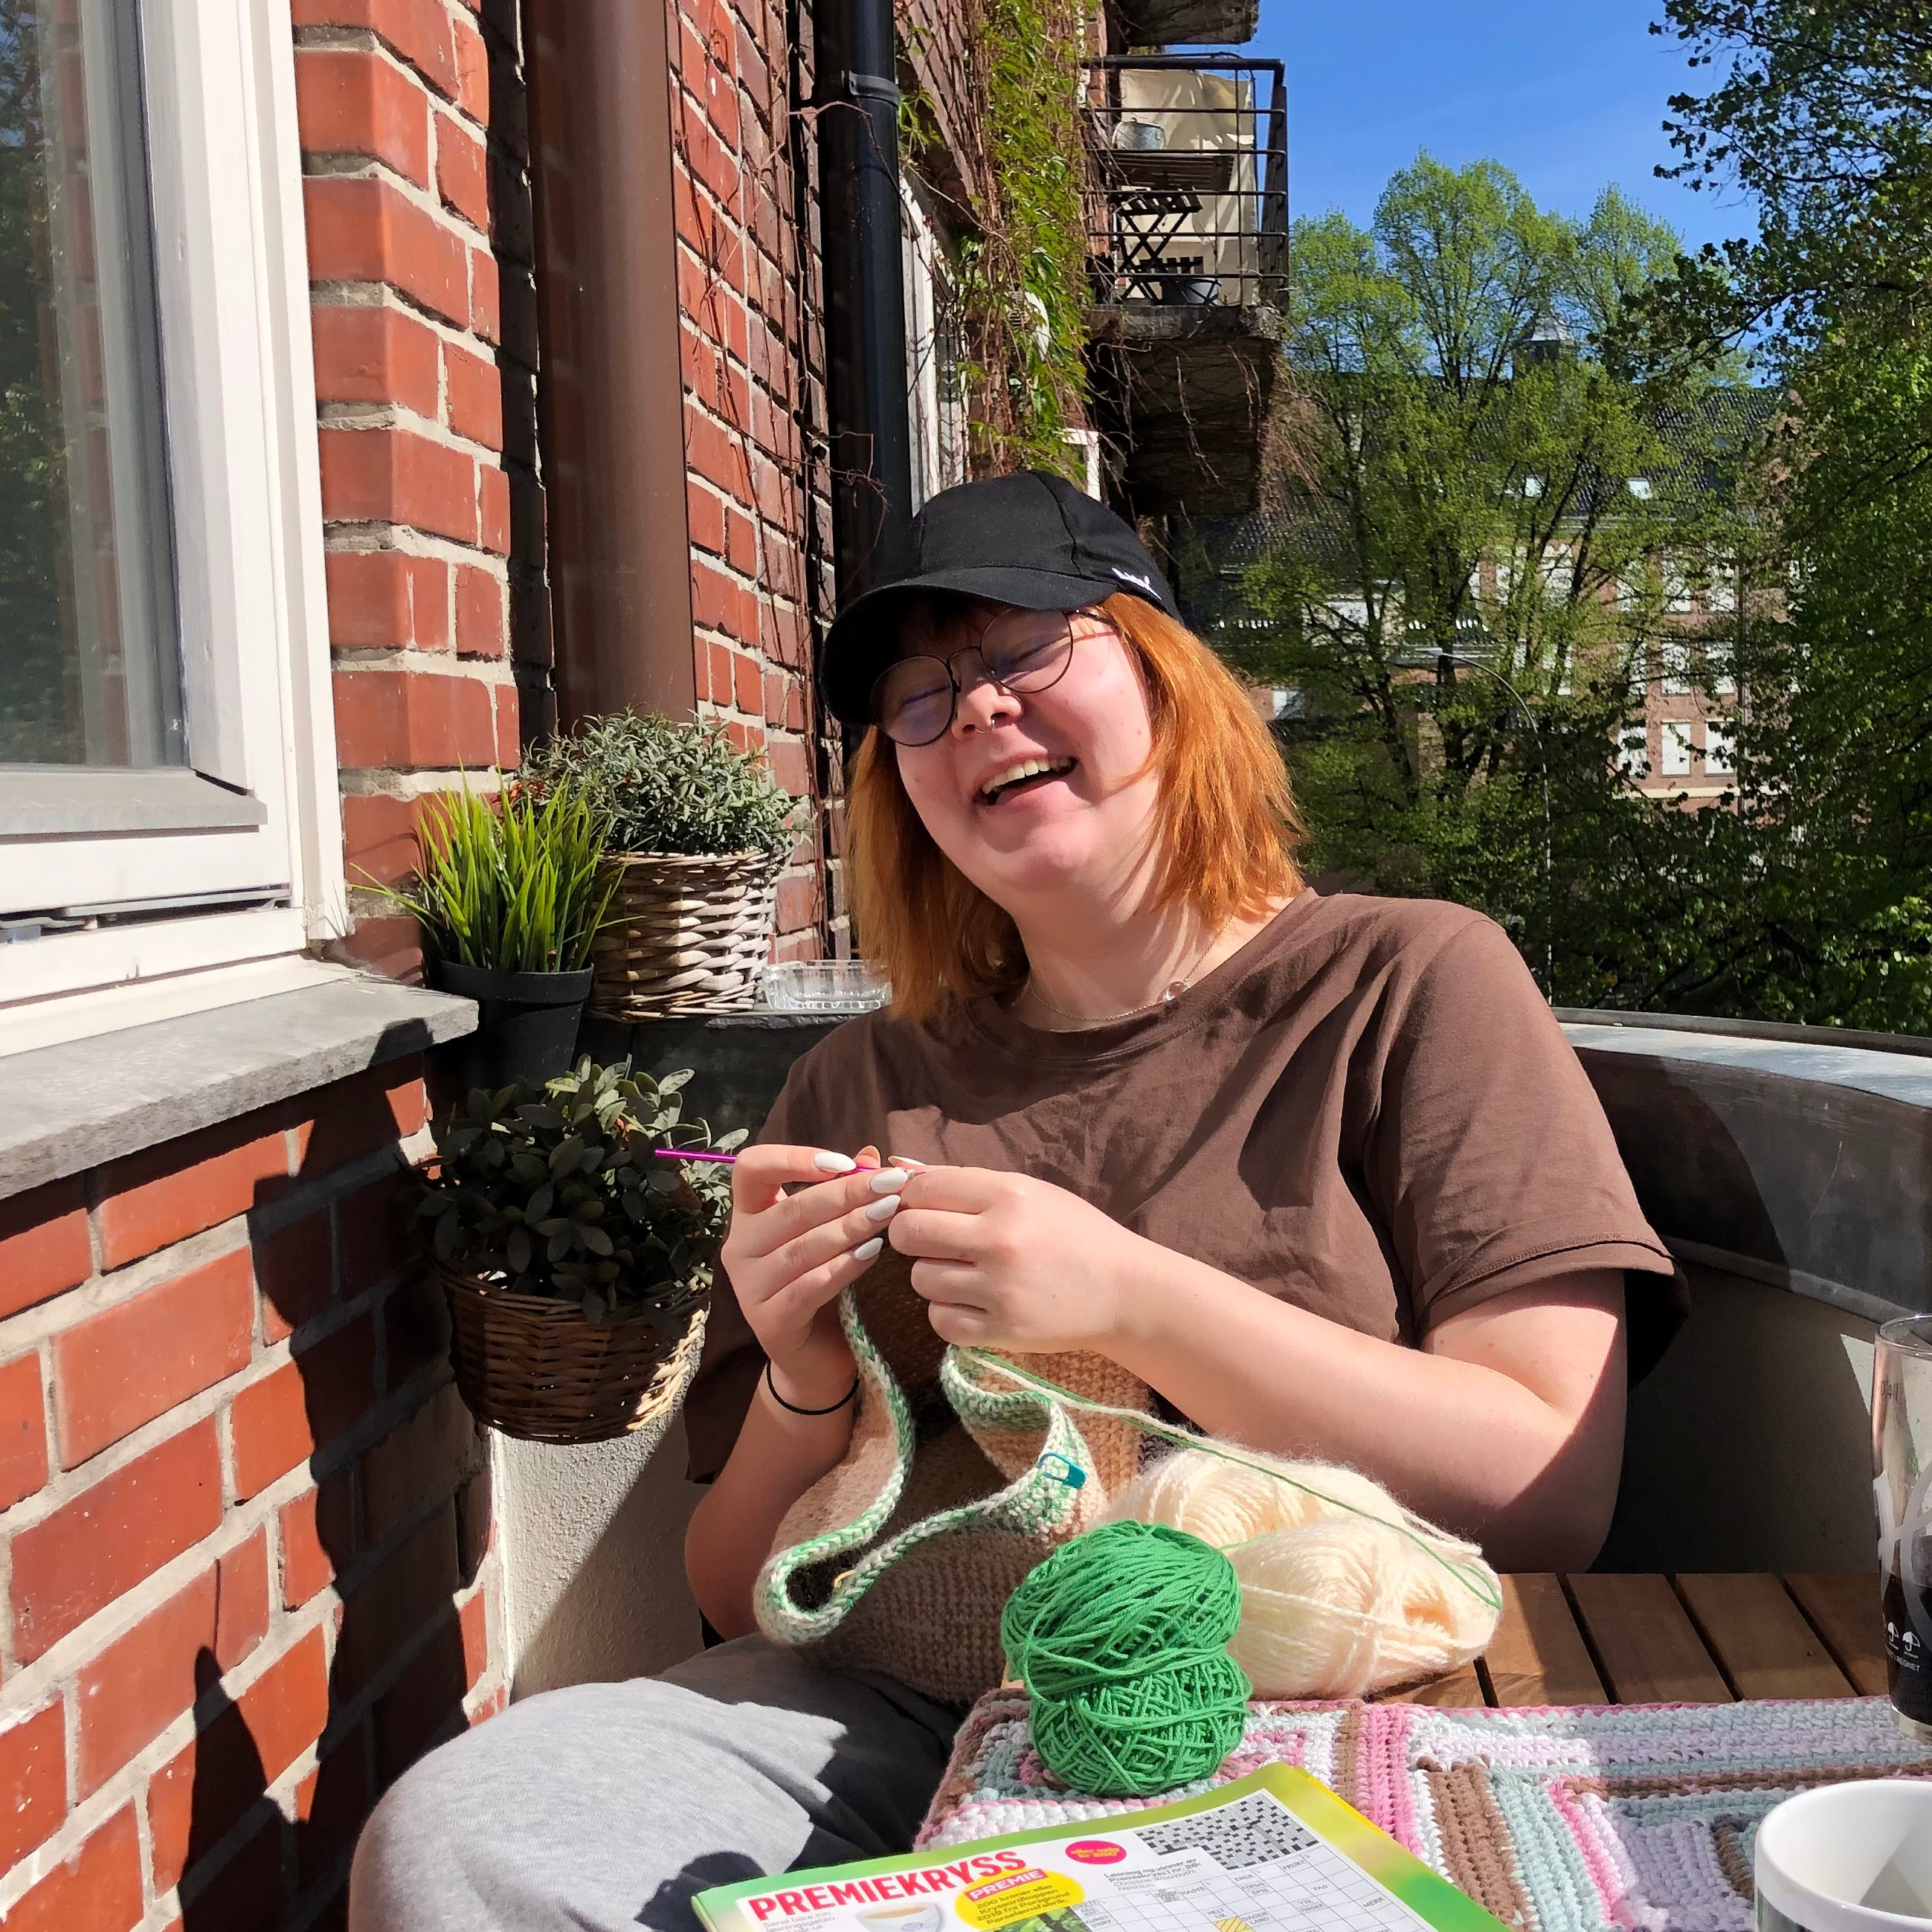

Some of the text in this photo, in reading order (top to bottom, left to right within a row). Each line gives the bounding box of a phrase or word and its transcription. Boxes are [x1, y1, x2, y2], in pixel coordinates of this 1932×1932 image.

[1155, 1861, 1184, 1871] vinner
[748, 1851, 1027, 1922] PREMIEKRYSS
[969, 1870, 1044, 1900] PREMIE
[976, 1899, 998, 1909] 200
[999, 1890, 1031, 1902] kroner
[979, 1889, 1059, 1914] Kryssordkoppen
[1020, 1891, 1071, 1907] Porsgrund
